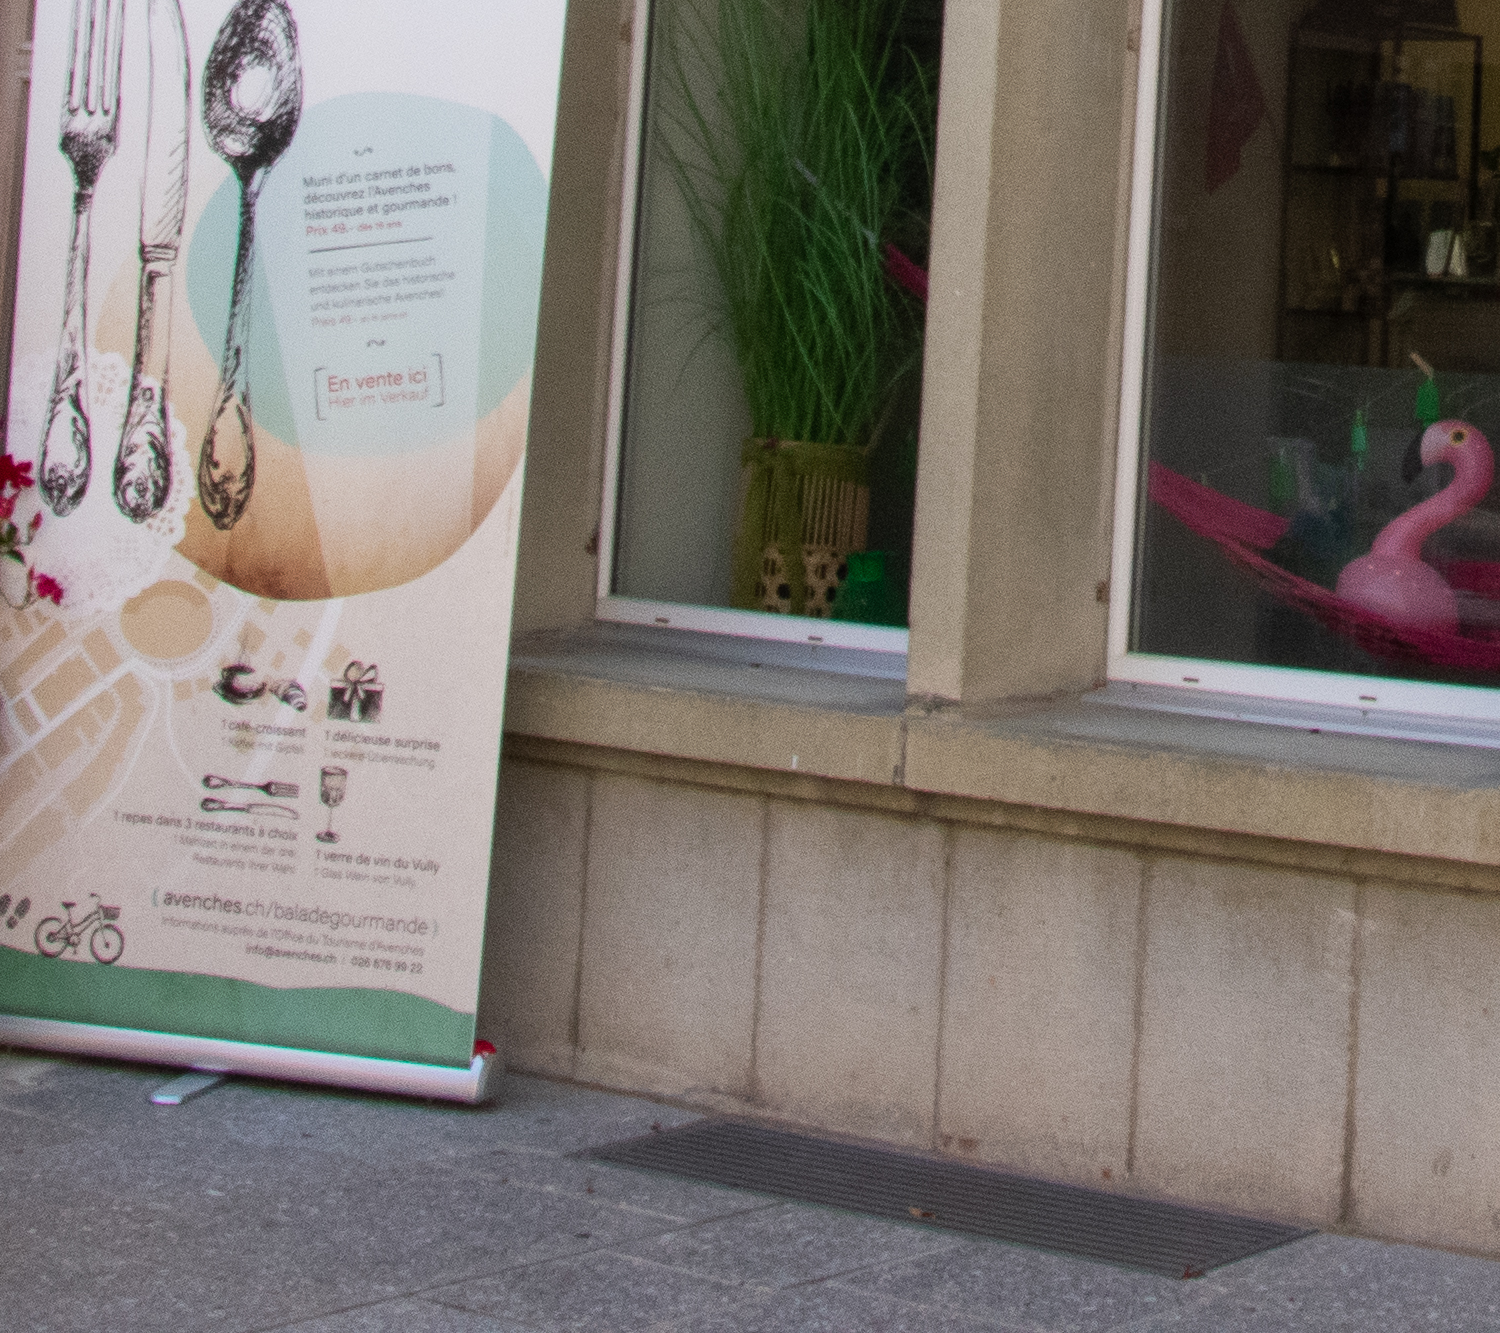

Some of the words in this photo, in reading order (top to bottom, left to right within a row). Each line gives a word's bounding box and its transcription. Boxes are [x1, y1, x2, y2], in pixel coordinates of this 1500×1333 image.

[303, 175, 332, 188] Muni
[335, 172, 362, 184] d'un
[364, 167, 403, 182] carnet
[405, 165, 421, 176] de
[304, 188, 365, 205] découvrez
[368, 182, 431, 197] l'Avenches
[304, 204, 364, 221] historique
[367, 204, 379, 214] et
[382, 195, 450, 215] gourmande
[306, 223, 328, 237] Prix
[308, 266, 324, 278] Mit
[327, 264, 357, 276] einem
[309, 281, 360, 295] entdecken
[364, 277, 379, 289] Sie
[382, 275, 400, 287] das
[402, 271, 456, 285] historische
[310, 300, 330, 311] und
[332, 291, 392, 309] kulinarische
[327, 374, 350, 393] En
[355, 371, 404, 390] vente
[408, 366, 429, 383] ici
[328, 394, 356, 408] Hier
[360, 393, 376, 405] im
[380, 387, 429, 404] Verkauf
[228, 720, 307, 738] café-croissant
[332, 729, 391, 746] délicieuse
[394, 737, 441, 753] surprise
[121, 811, 153, 827] repas
[156, 814, 183, 828] dans
[185, 817, 192, 829] 3
[194, 819, 256, 837] restaurants
[268, 825, 299, 841] choix
[323, 852, 355, 865] verre
[357, 854, 372, 866] de
[374, 856, 391, 869] vin
[394, 857, 409, 870] du
[412, 858, 441, 876] Vully
[163, 890, 429, 935] avenches.ch/baladegourmande
[161, 915, 219, 933] Informations
[322, 934, 366, 951] Tourisme
[245, 943, 337, 965] info@avenches.ch
